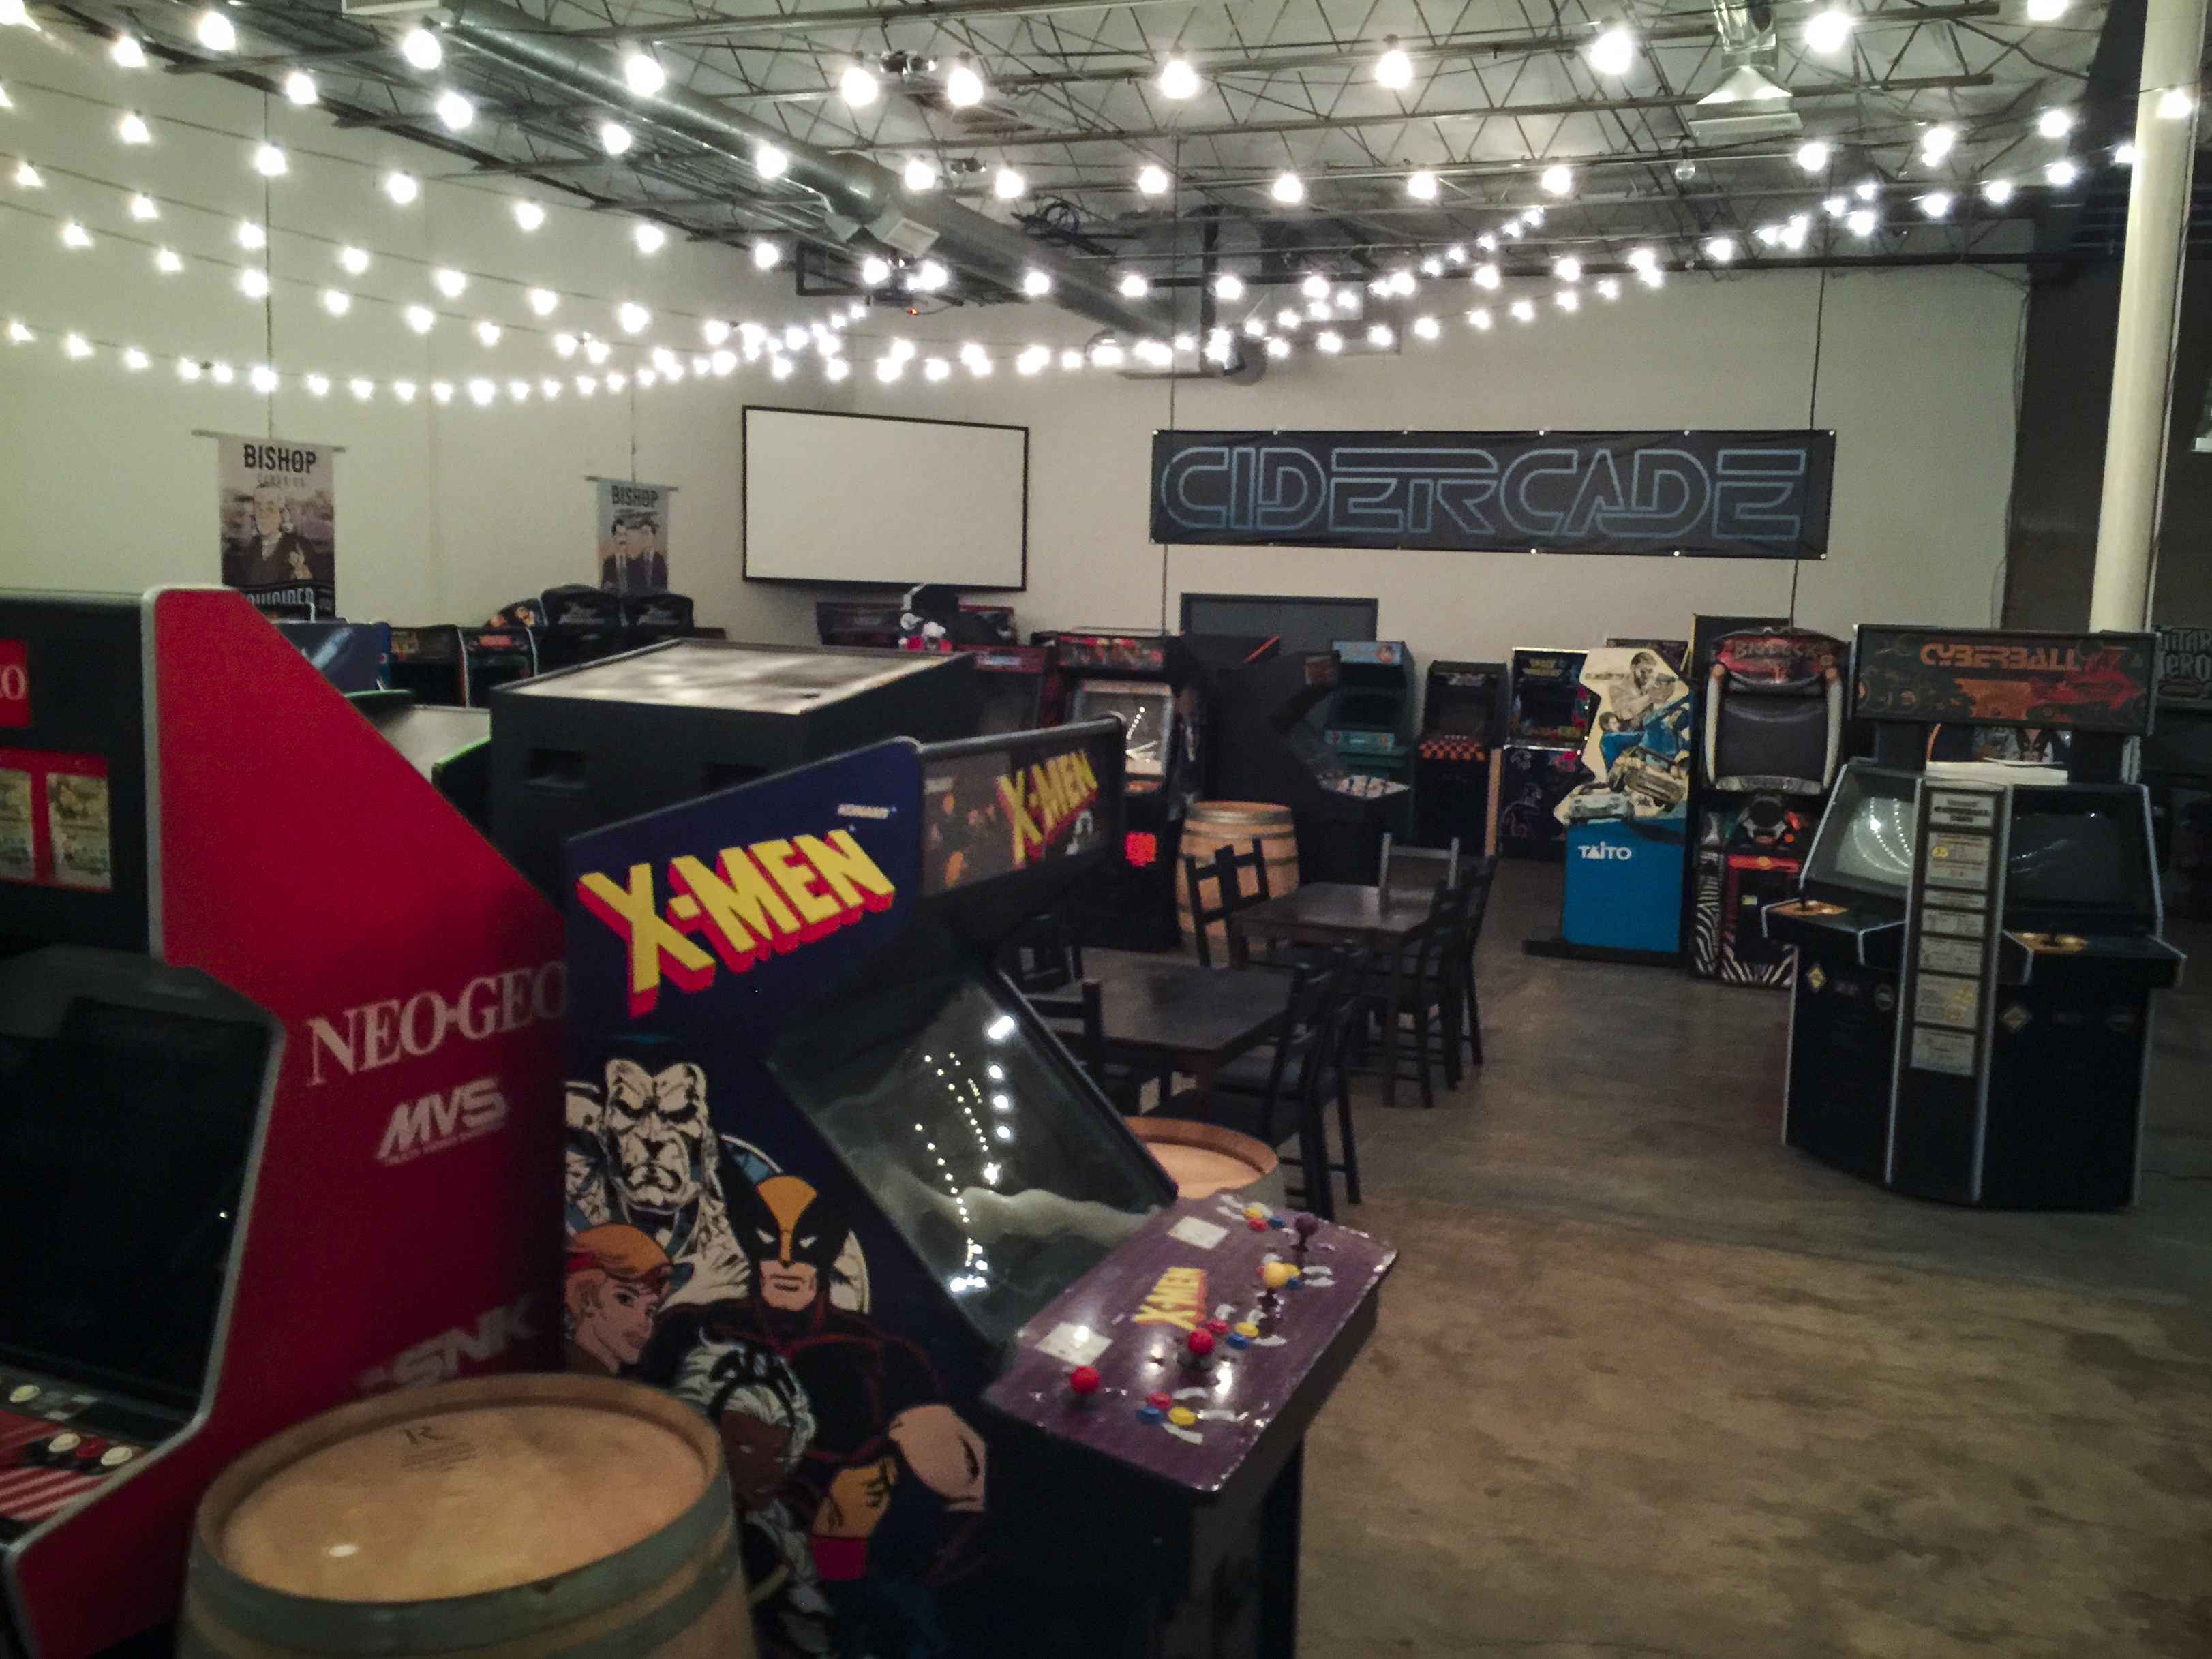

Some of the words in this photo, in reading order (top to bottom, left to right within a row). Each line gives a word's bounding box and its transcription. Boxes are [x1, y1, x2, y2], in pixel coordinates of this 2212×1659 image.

[244, 444, 316, 473] BISHOP
[611, 485, 658, 508] BISHOP
[1160, 447, 1806, 540] CIDERCADE
[1920, 643, 2082, 671] CYBERBALL
[994, 748, 1098, 870] X-MEN
[1577, 840, 1633, 861] TAITO
[575, 828, 896, 1018] X-MEN
[376, 1077, 509, 1166] MVS
